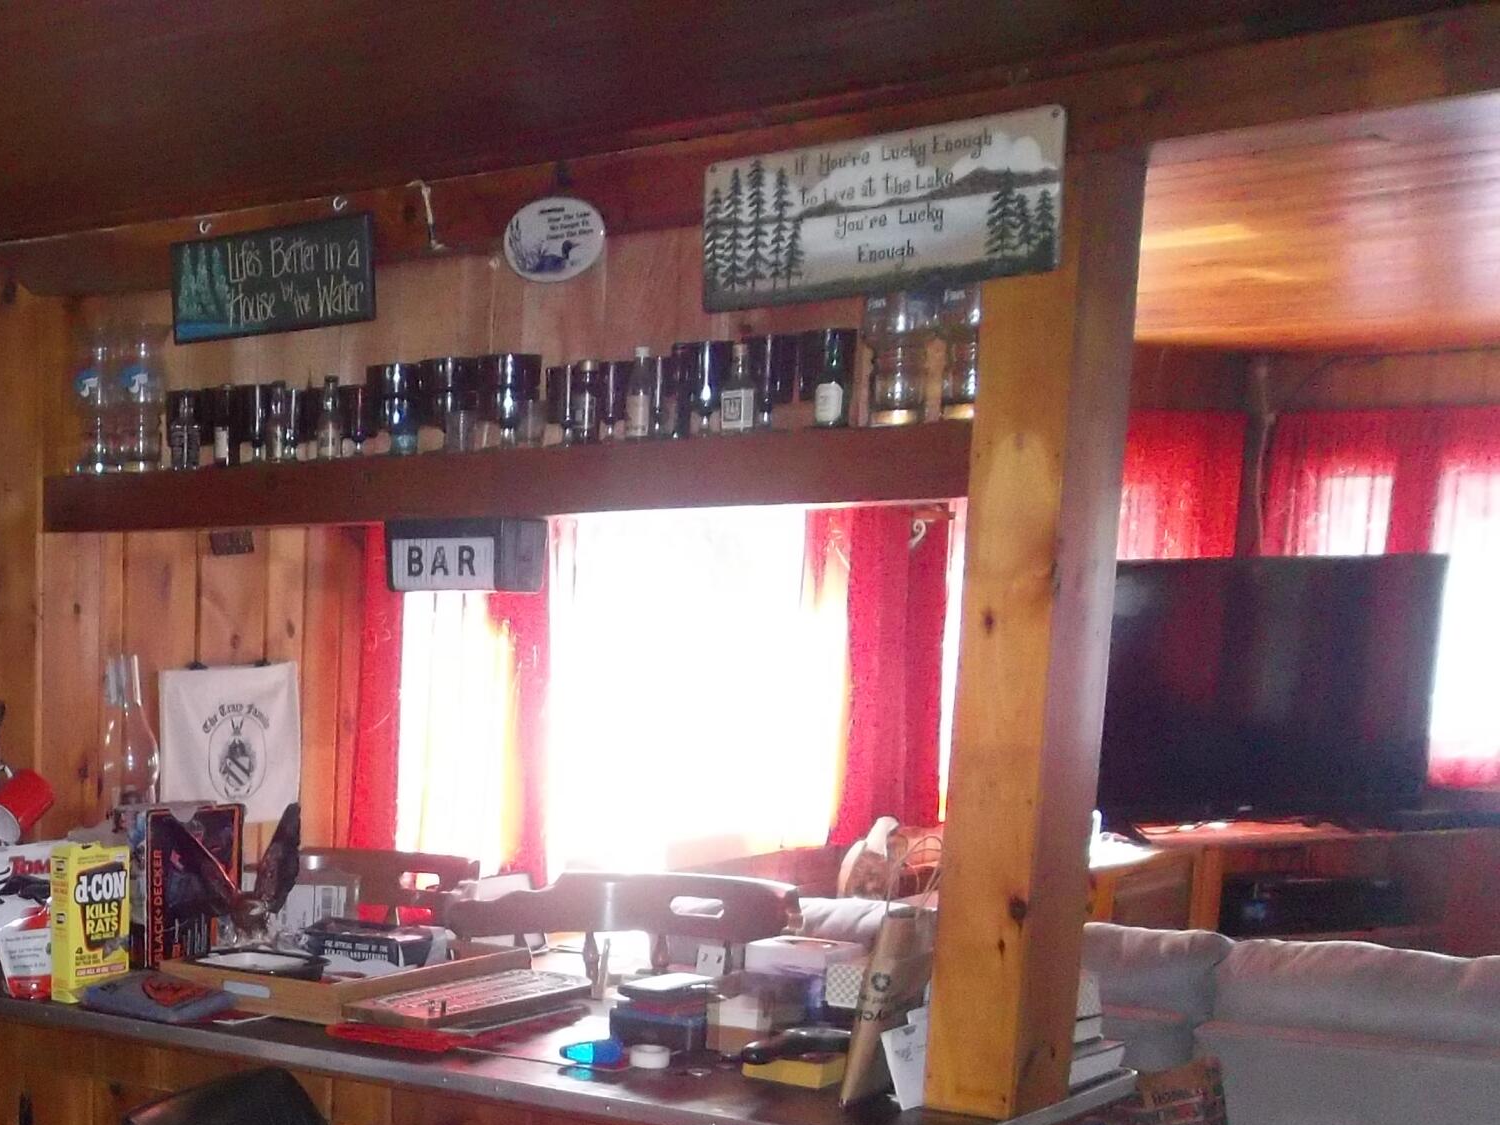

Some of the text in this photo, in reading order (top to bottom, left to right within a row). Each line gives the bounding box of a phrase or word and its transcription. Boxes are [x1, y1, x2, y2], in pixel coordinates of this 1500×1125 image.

[794, 127, 992, 178] If You're Lucky Enough
[861, 178, 877, 199] at
[885, 174, 912, 195] the
[915, 169, 954, 191] Lake
[834, 202, 945, 239] You're Lucky
[270, 236, 320, 279] Better
[324, 239, 341, 271] in
[347, 239, 360, 268] a
[857, 239, 916, 267] Enough
[227, 283, 276, 328] House
[316, 274, 364, 320] Water
[407, 545, 476, 577] BAR
[86, 901, 119, 920] KILLS
[86, 918, 119, 936] RATS
